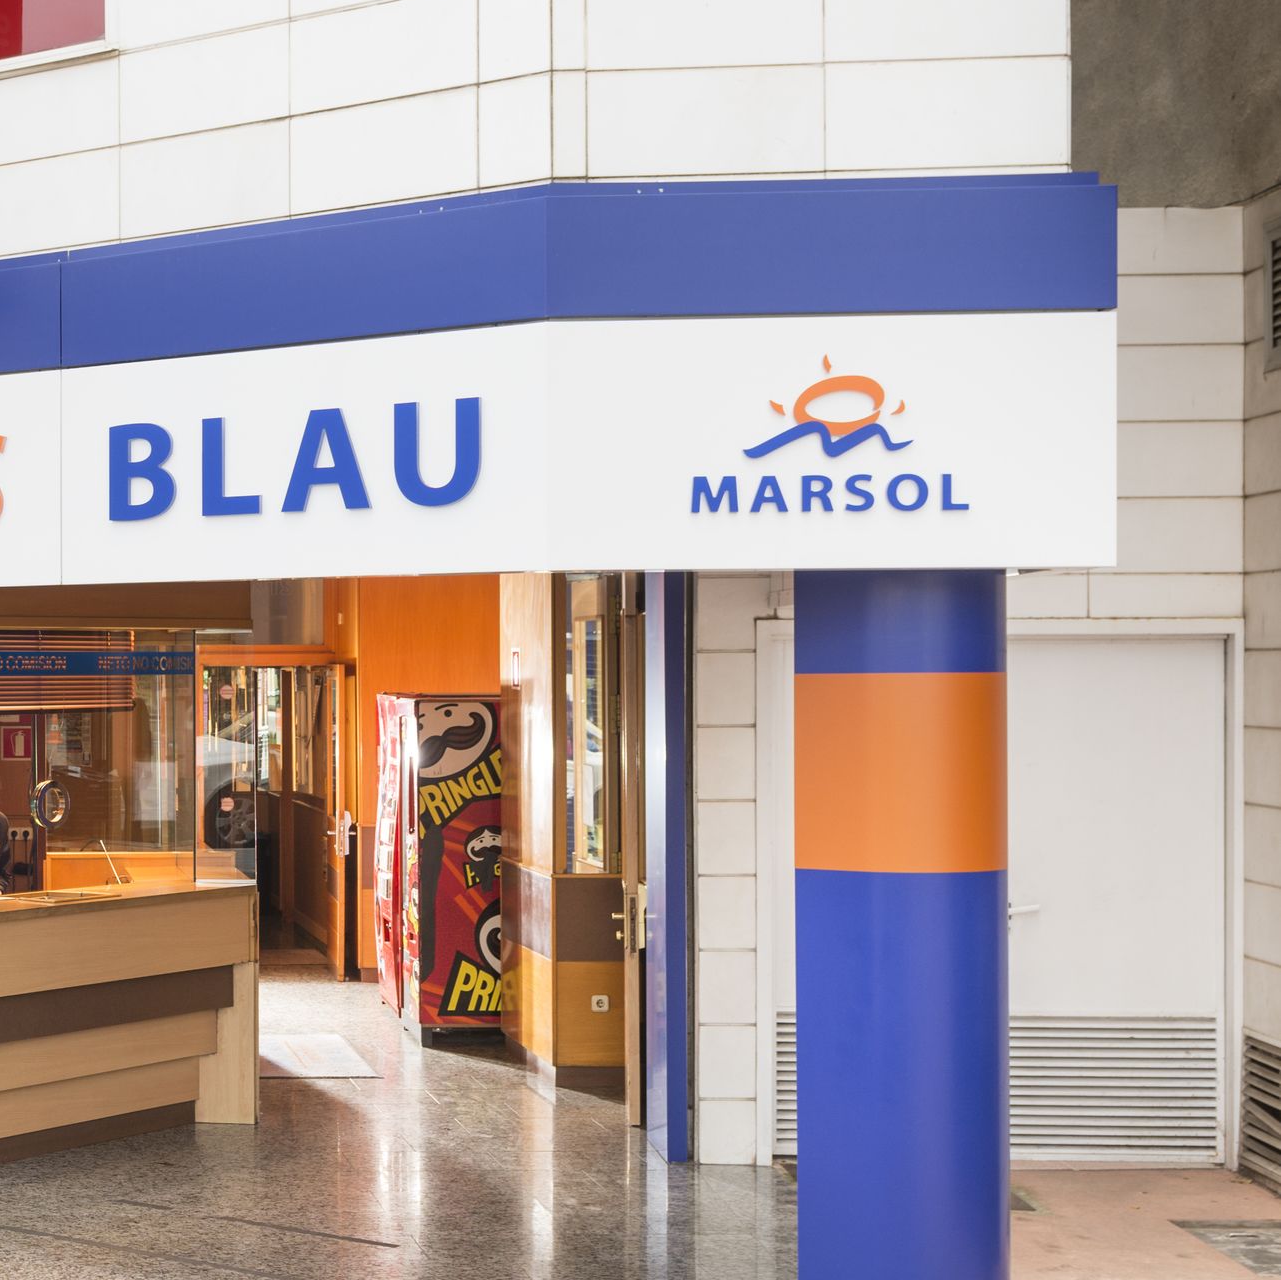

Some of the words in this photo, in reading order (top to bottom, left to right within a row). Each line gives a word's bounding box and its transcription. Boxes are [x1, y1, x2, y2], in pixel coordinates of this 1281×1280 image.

[108, 396, 482, 522] BLAU
[691, 473, 969, 513] MARSOL
[6, 655, 67, 671] COMISION
